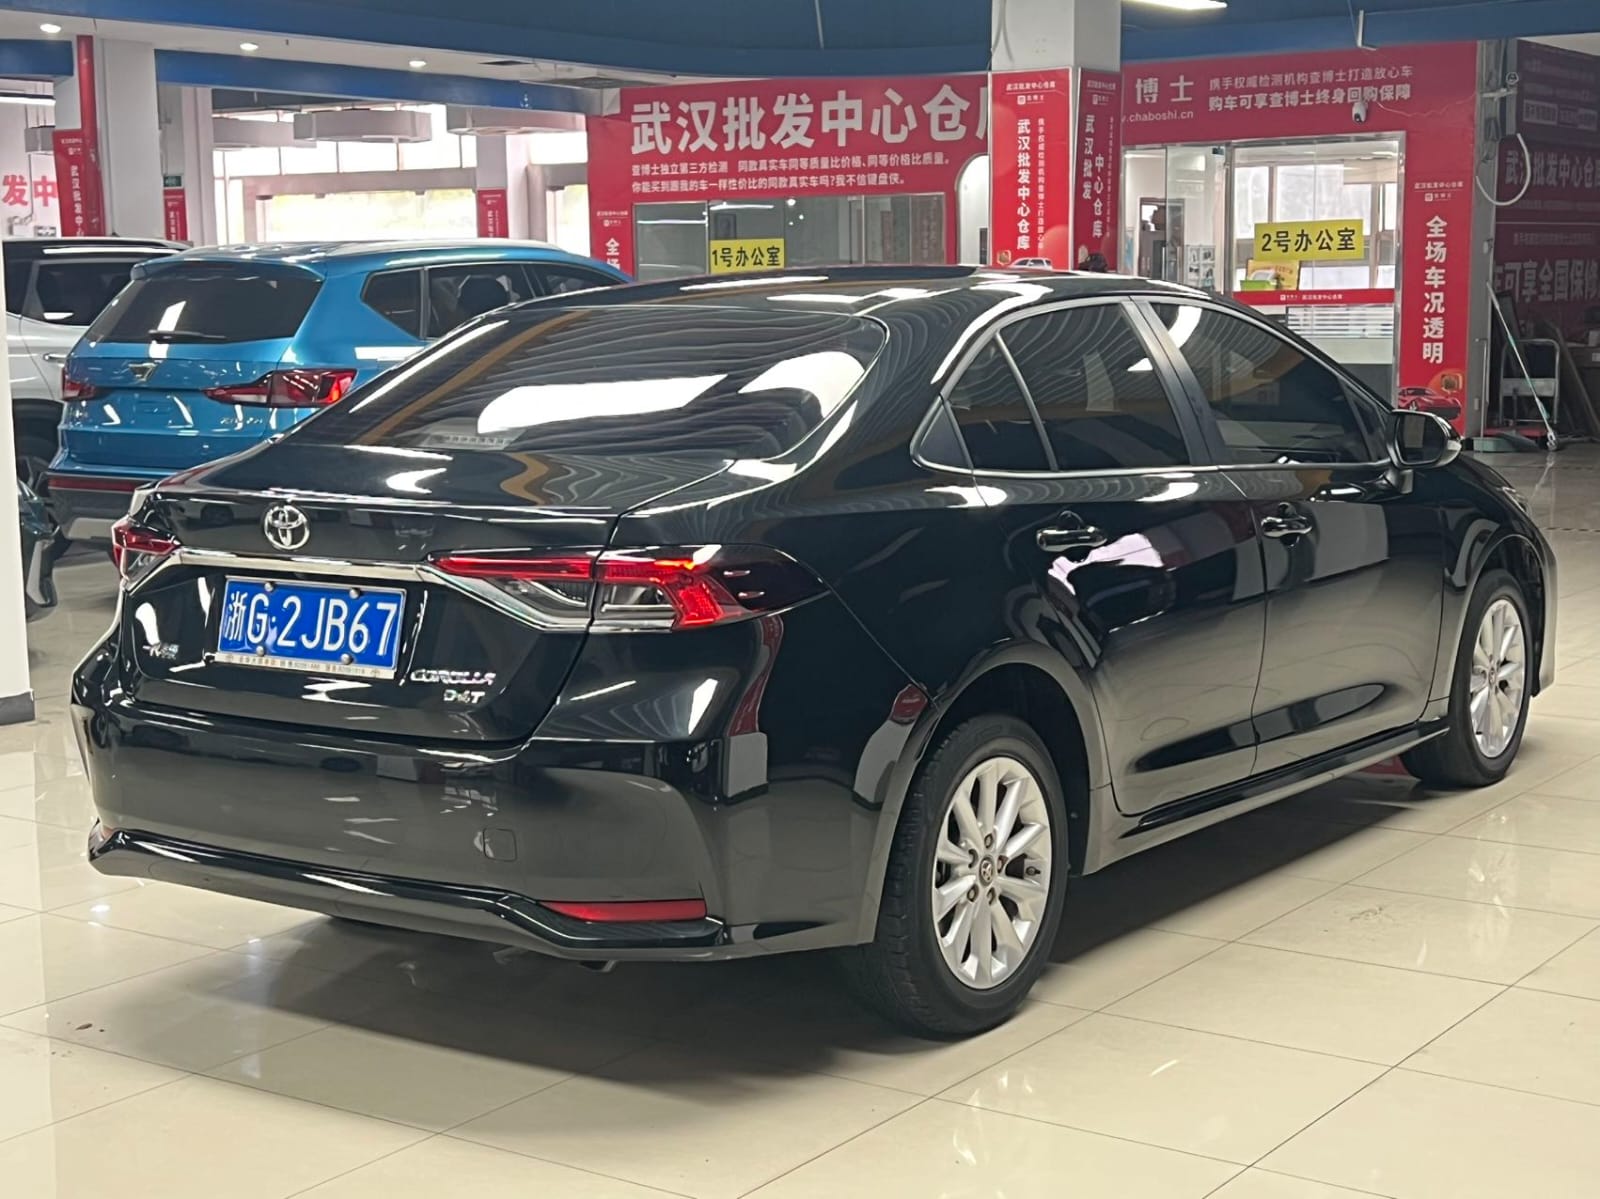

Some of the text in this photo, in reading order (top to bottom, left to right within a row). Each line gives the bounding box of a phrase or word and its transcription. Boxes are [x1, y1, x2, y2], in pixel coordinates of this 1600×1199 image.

[1208, 83, 1411, 111] 购车可享查博士终身回购保障
[1016, 118, 1031, 250] 武汉批发中心仓库
[1261, 226, 1356, 253] 2号办公室
[710, 245, 782, 268] 1号办公室
[1421, 215, 1448, 365] 全场车况透明
